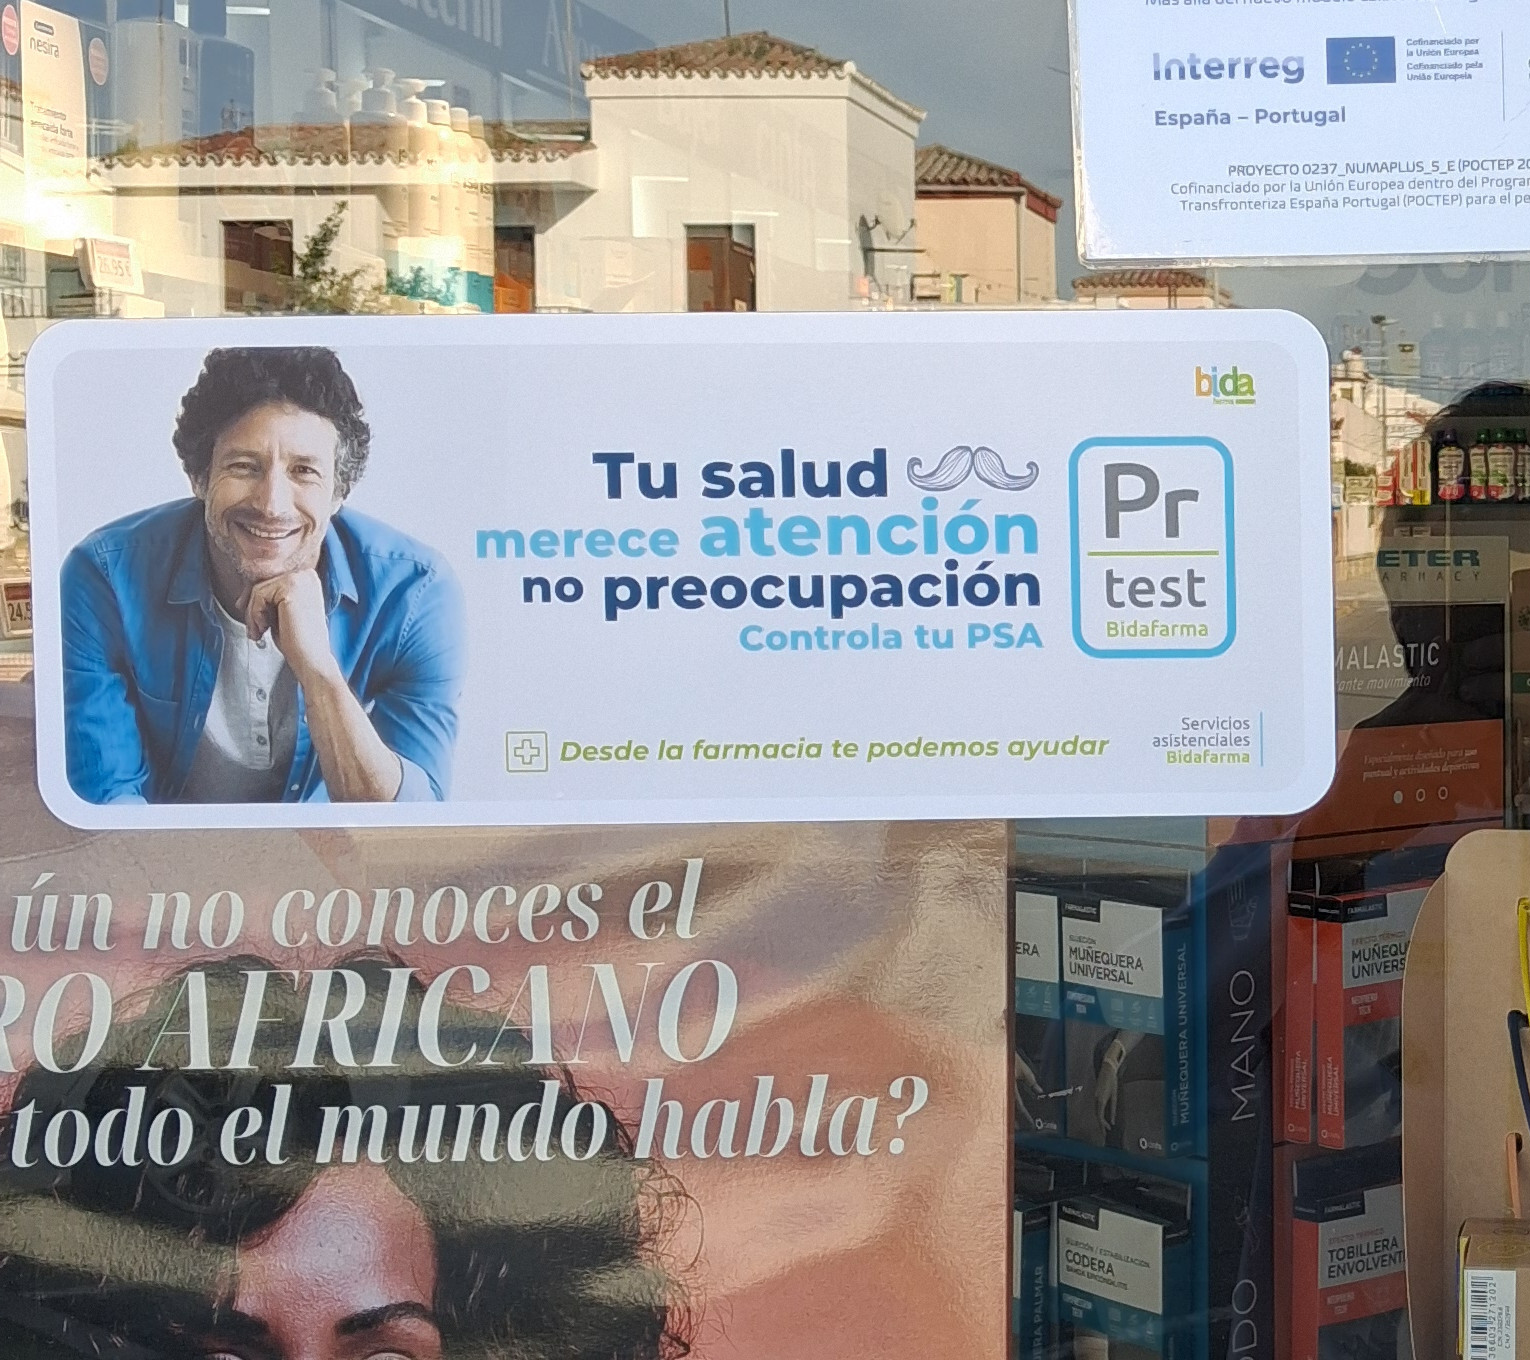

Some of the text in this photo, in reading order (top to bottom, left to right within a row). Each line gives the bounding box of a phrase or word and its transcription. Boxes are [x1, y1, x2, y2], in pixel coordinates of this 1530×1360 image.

[1152, 52, 1305, 84] Interreg
[1154, 106, 1346, 130] España Portugal
[1228, 163, 1300, 176] PROYECTO
[1458, 158, 1514, 173] (POCTEP
[1171, 181, 1260, 195] Cofinanciado
[1263, 183, 1286, 196] por
[1290, 180, 1301, 193] la
[1304, 178, 1344, 192] Unión
[1349, 179, 1405, 194] Europea
[1408, 176, 1454, 190] dentro
[1458, 175, 1477, 189] del
[1180, 198, 1286, 212] Transfronteriza
[1290, 196, 1338, 212] España
[1343, 195, 1401, 211] Portugal
[1403, 192, 1463, 208] (POCTEP)
[1466, 194, 1496, 209] para
[1500, 191, 1511, 205] el
[1195, 365, 1255, 397] bida
[592, 447, 888, 500] Tu salud
[1103, 462, 1201, 541] Pr
[476, 496, 1039, 559] merece atención
[522, 558, 1041, 622] no preocupación
[1104, 566, 1208, 610] test
[739, 621, 1045, 652] Controla tu PSA
[1105, 619, 1210, 640] Bidafarma
[1366, 674, 1431, 689] movimiento
[1152, 730, 1251, 748] asistenciales
[1181, 715, 1251, 733] Servicios
[559, 732, 1110, 766] Desde la farmacia te podemos ayudar
[1166, 747, 1251, 766] Bidafarma
[11, 857, 703, 952] ún no conoces el
[1068, 944, 1144, 972] MUÑEQUERA
[1069, 961, 1134, 986] UNIVERSAL
[141, 958, 740, 1073] AFRICANO
[1177, 943, 1190, 1125] MUÑEQUERA UNIVERSAL
[1230, 969, 1256, 1123] MANO
[10, 1073, 931, 1171] todo el mundo habla?
[1065, 1249, 1115, 1277] CODERA
[1327, 1235, 1399, 1262] TOBILLERA
[1034, 1265, 1045, 1325] PALMAR
